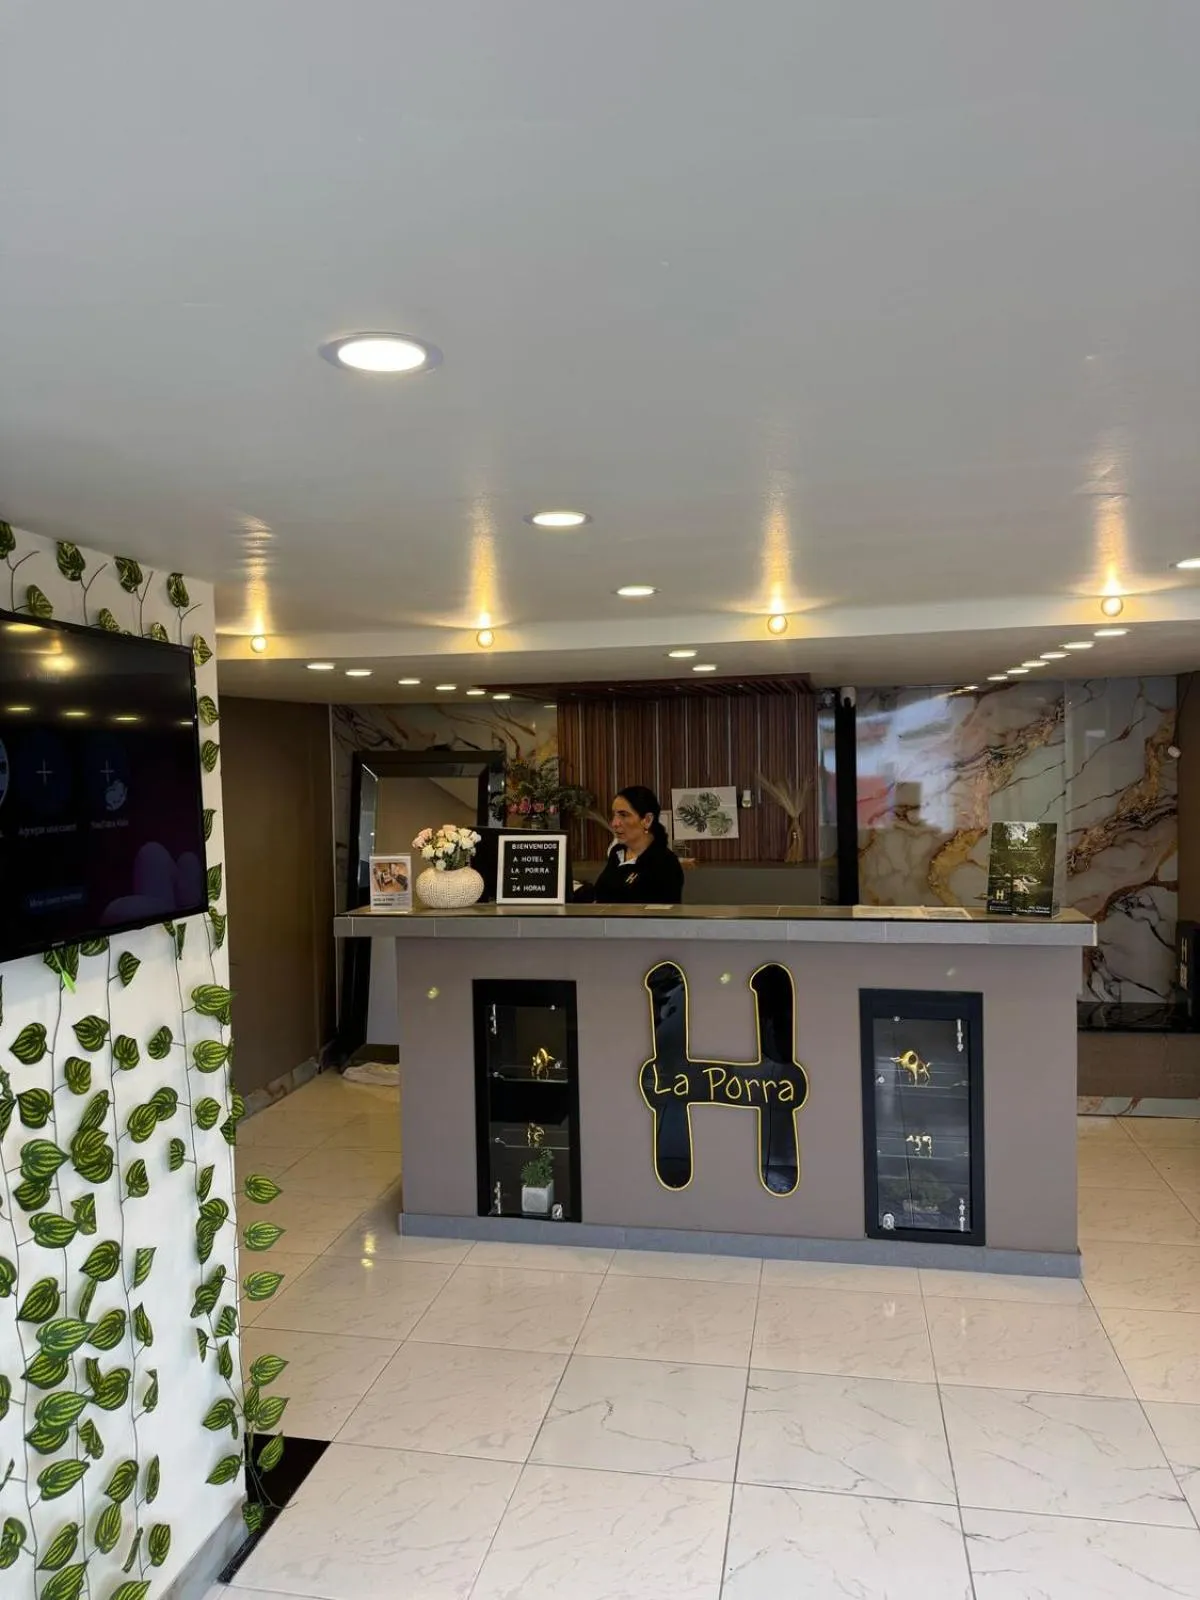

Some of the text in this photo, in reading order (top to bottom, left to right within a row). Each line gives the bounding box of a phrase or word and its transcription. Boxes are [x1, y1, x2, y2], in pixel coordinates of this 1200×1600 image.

[996, 889, 1004, 900] H
[653, 1063, 794, 1103] La Porra
